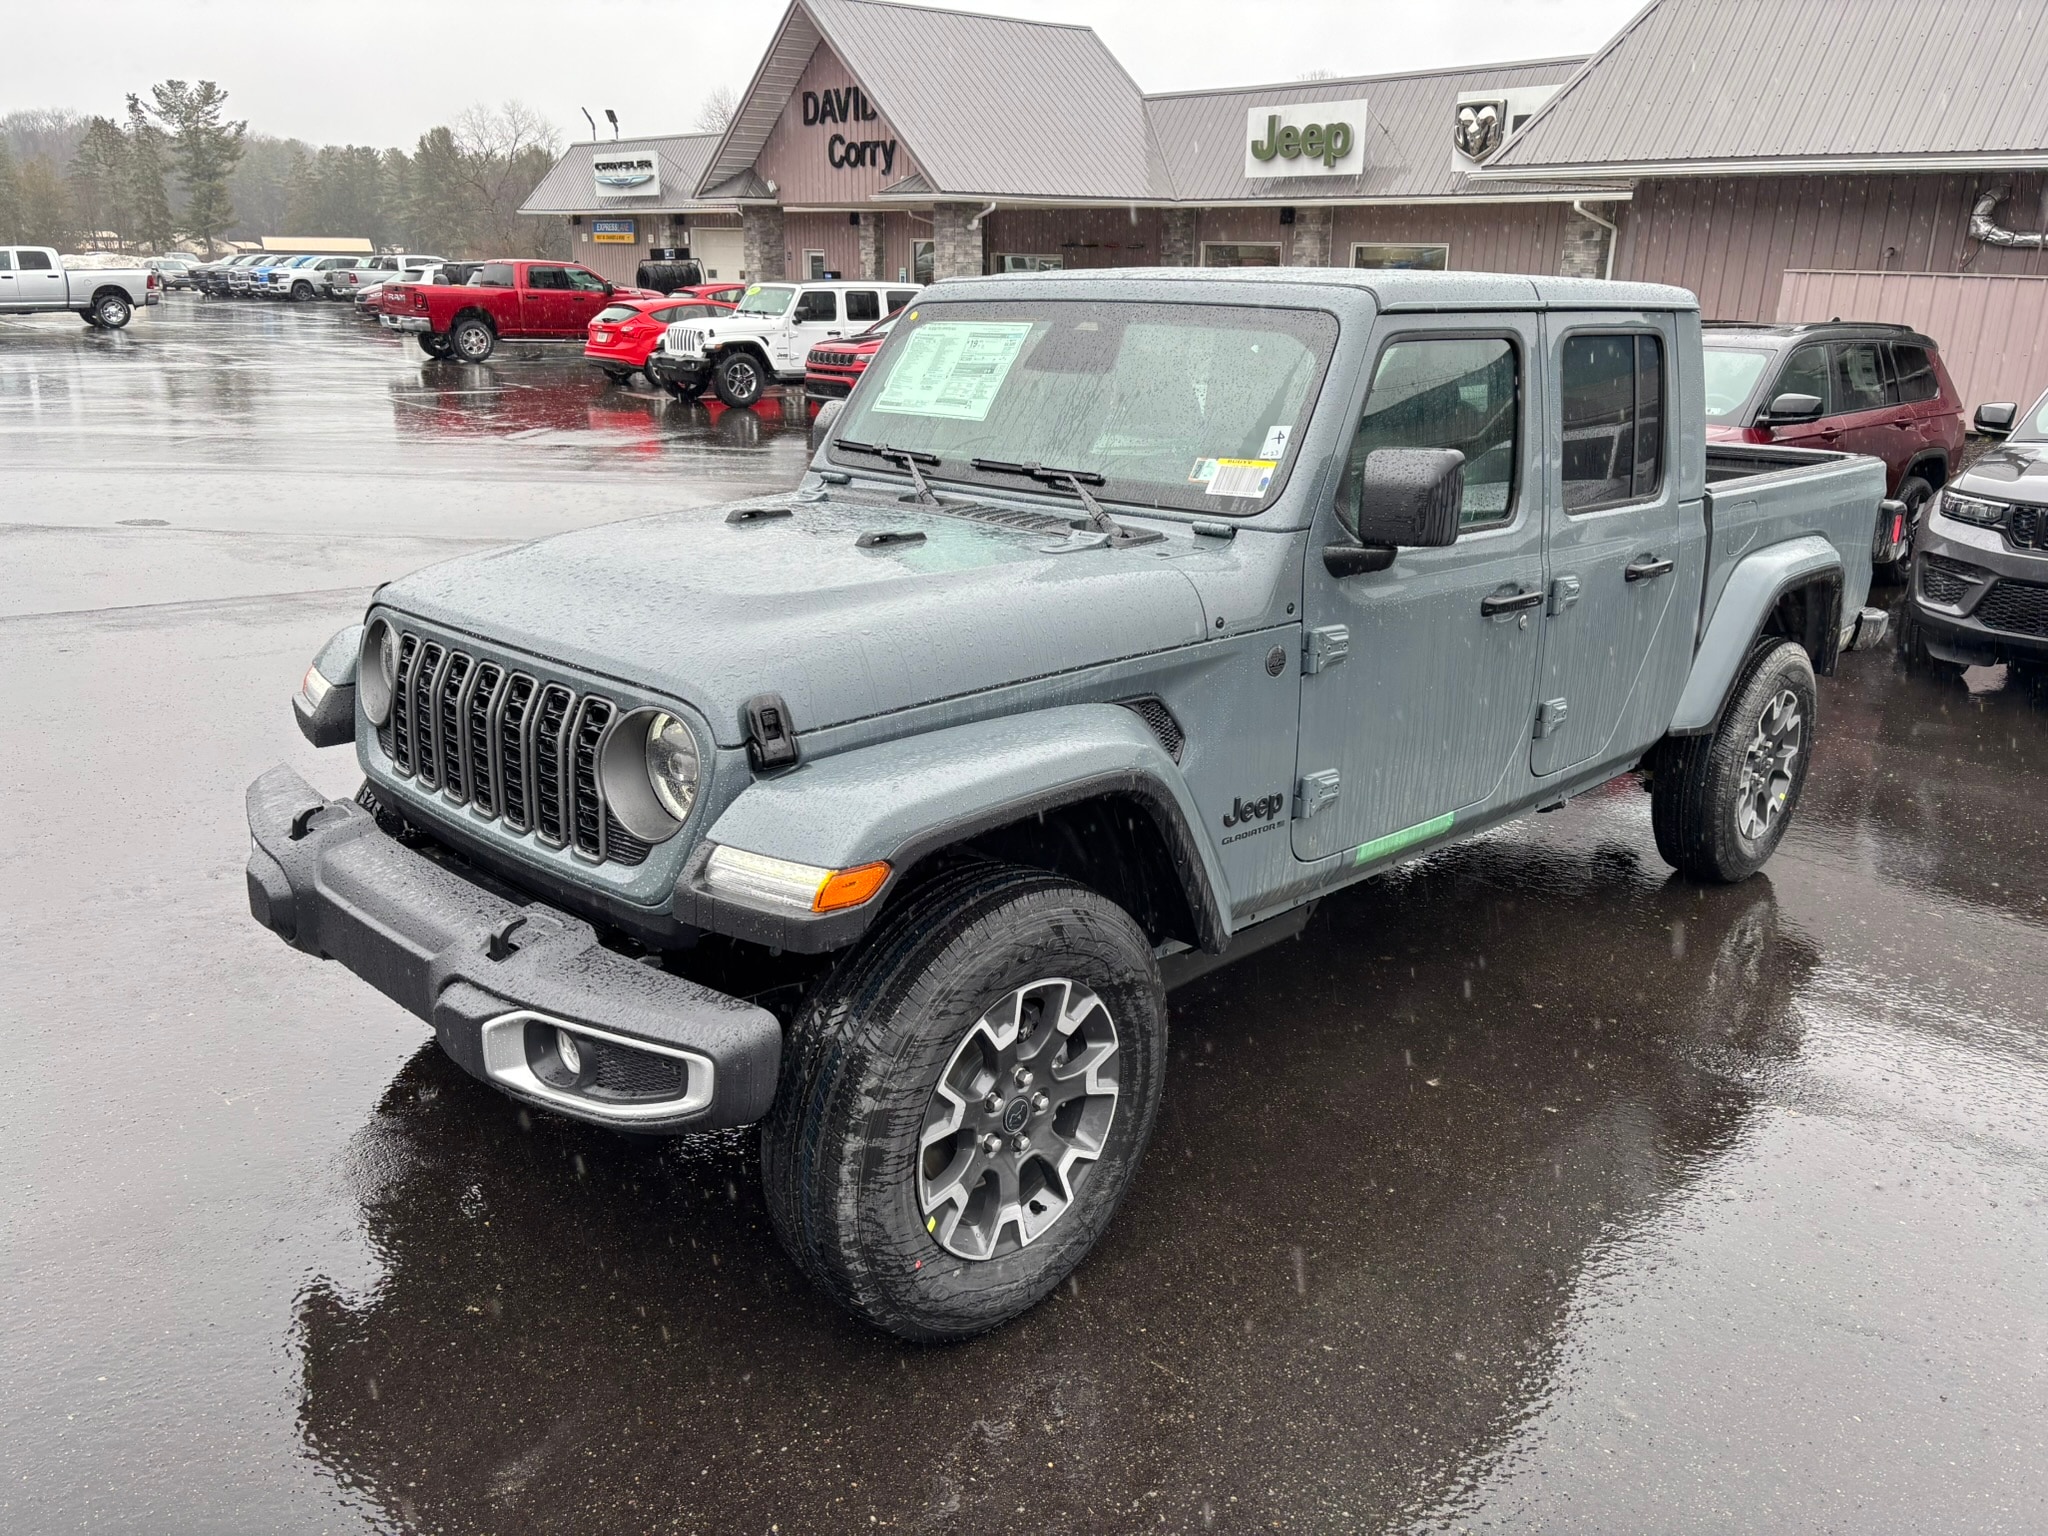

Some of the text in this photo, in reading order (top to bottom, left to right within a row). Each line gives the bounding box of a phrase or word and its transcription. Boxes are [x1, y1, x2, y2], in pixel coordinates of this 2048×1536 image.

[828, 133, 896, 176] Corry
[1251, 114, 1353, 168] Jeep
[1223, 792, 1283, 828] Jeep
[1221, 823, 1277, 846] GLADIATOR
